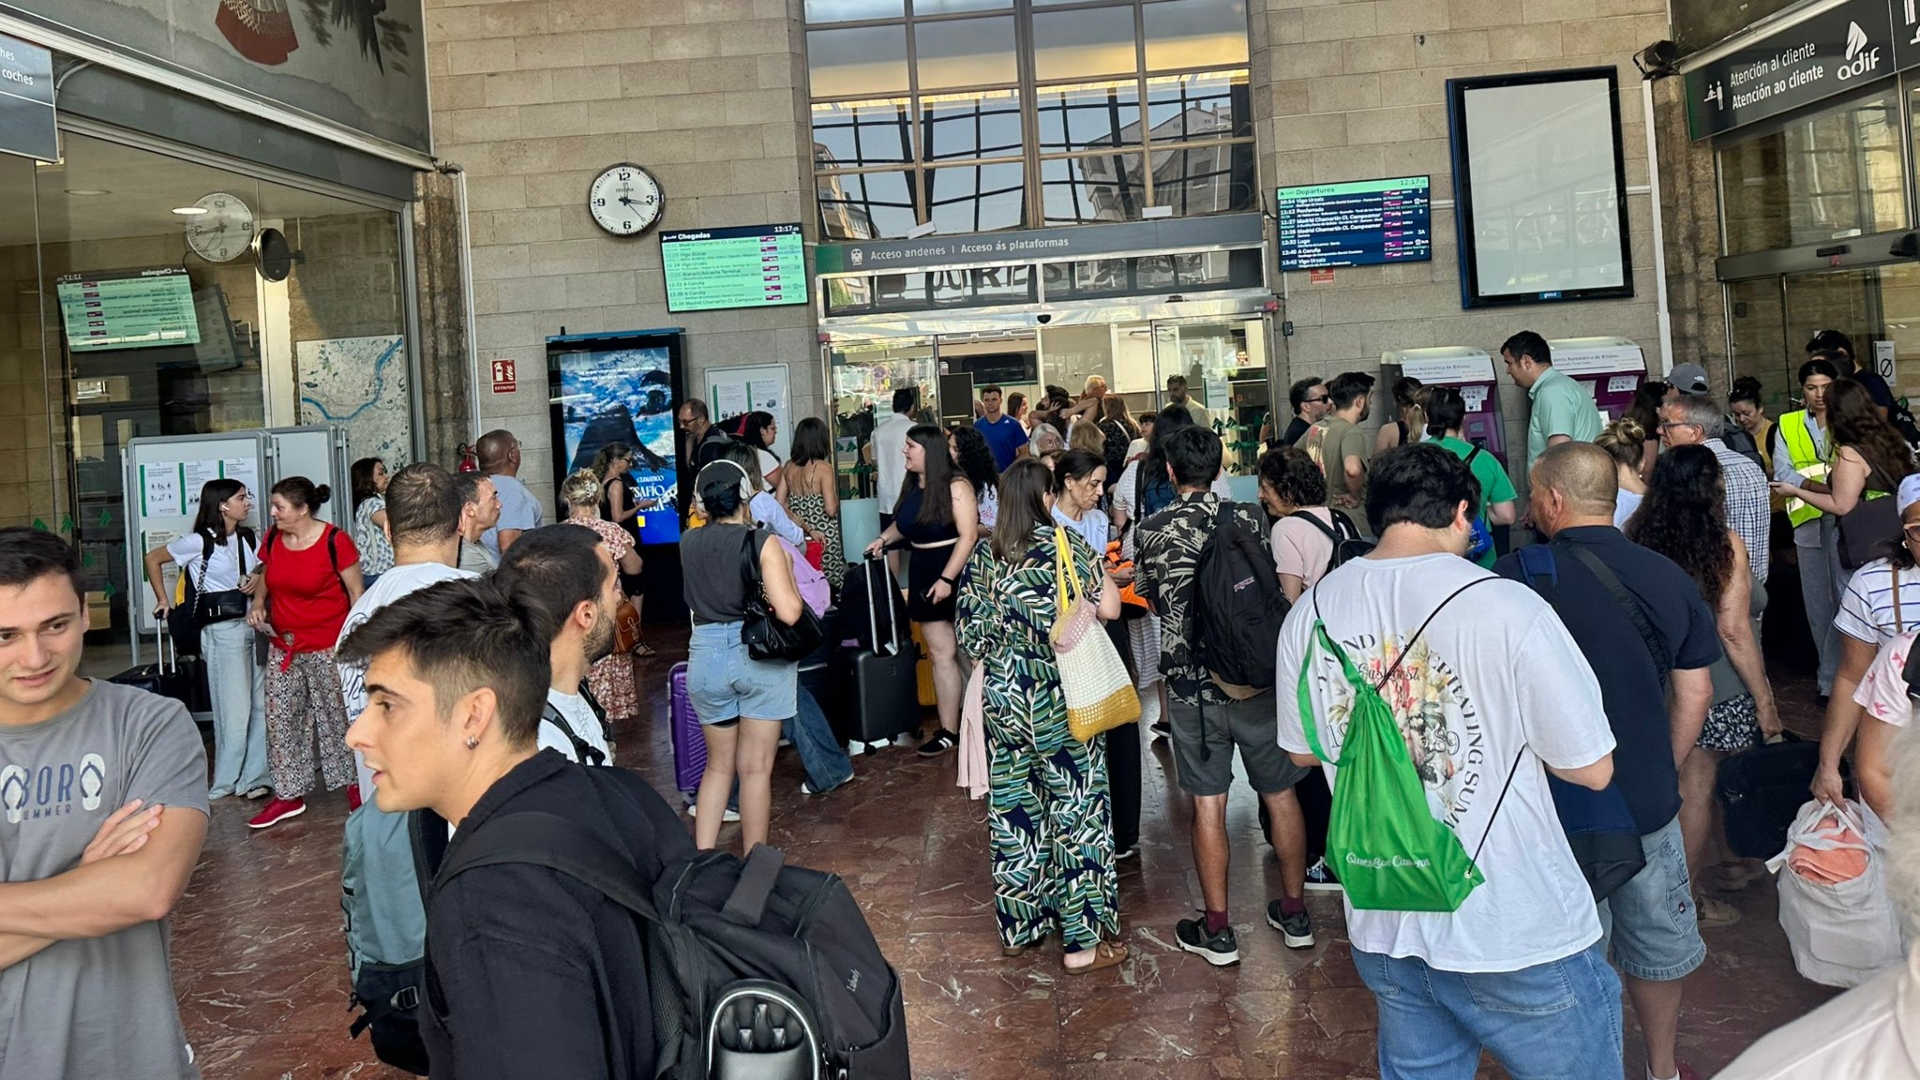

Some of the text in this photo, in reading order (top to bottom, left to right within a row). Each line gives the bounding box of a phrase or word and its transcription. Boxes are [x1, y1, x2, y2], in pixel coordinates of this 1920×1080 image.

[1730, 42, 1816, 88] Atención al cliente
[1837, 46, 1880, 81] adif
[2, 68, 34, 86] coches
[1732, 64, 1824, 110] Atención ao cliente
[618, 172, 631, 181] 12
[597, 198, 606, 206] 9
[646, 194, 654, 206] 3
[623, 220, 632, 230] 6
[678, 232, 710, 240] Chegadas
[870, 246, 946, 260] Acceso andenes
[960, 238, 1070, 254] Acceso ás plataformas
